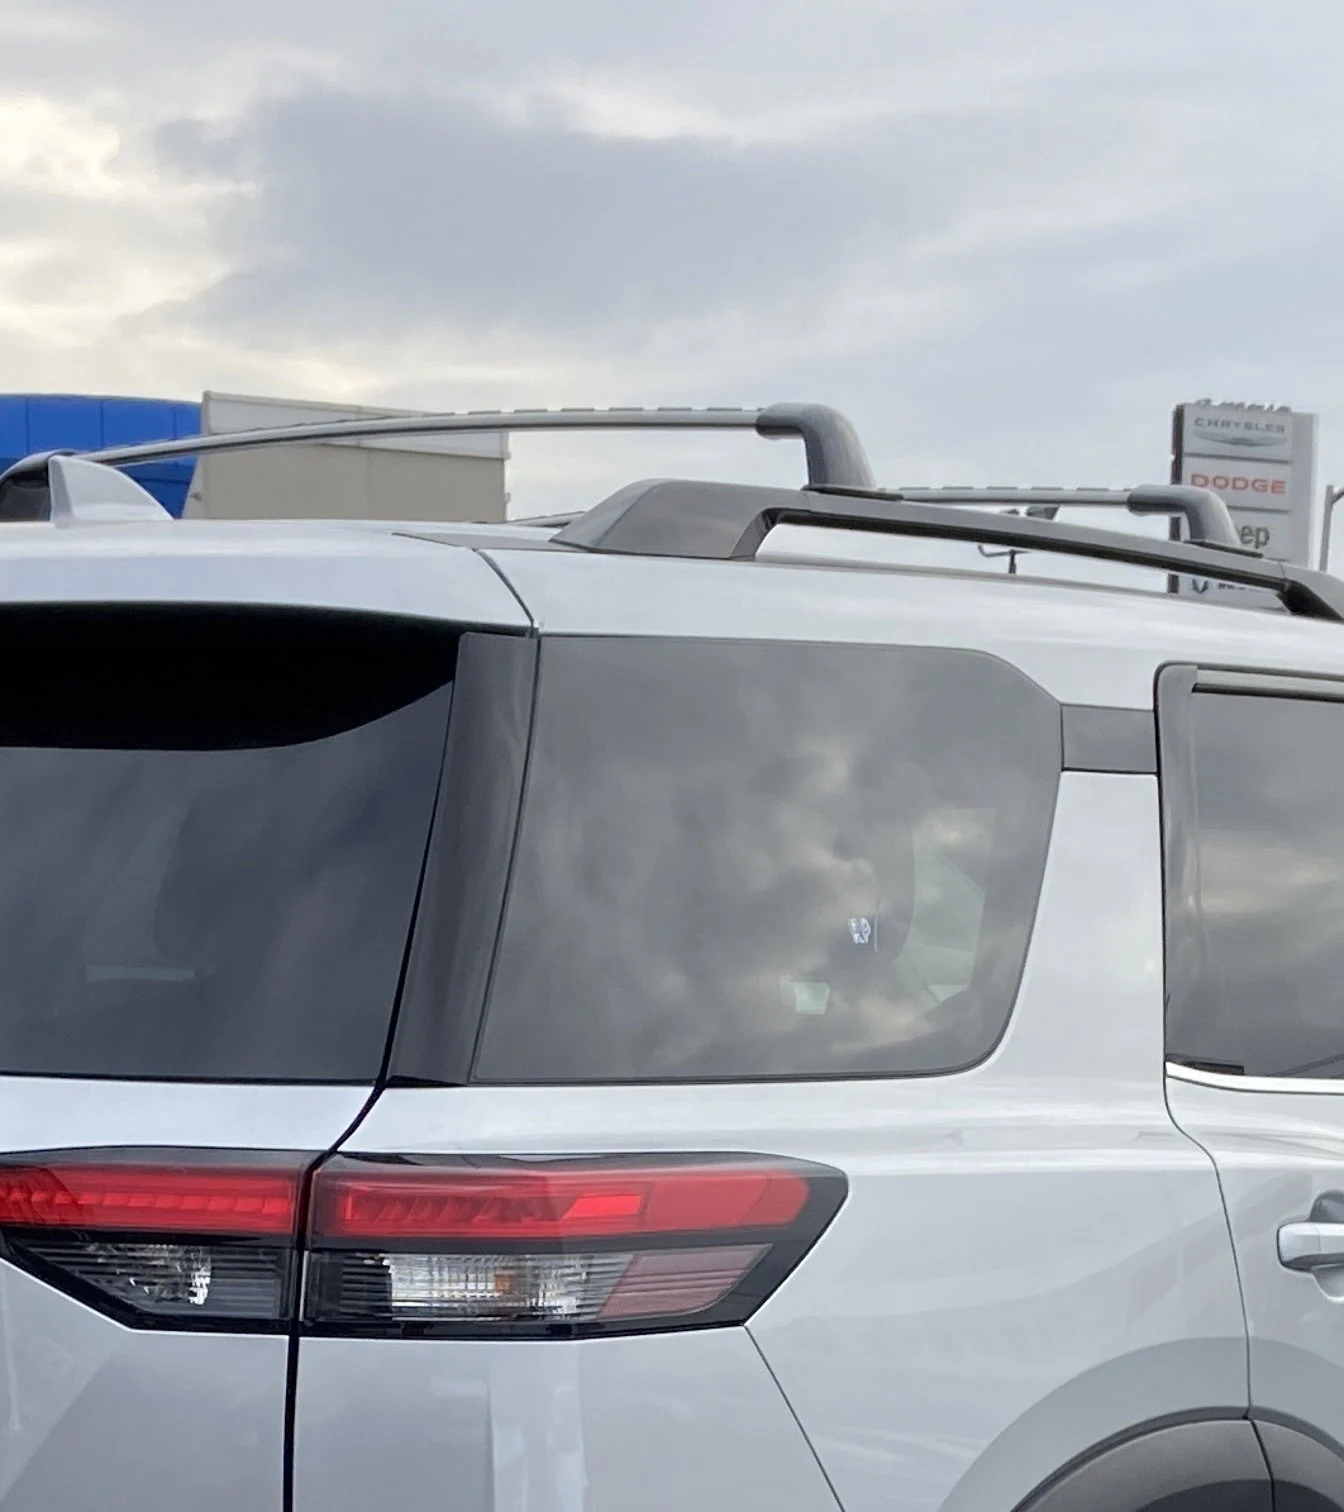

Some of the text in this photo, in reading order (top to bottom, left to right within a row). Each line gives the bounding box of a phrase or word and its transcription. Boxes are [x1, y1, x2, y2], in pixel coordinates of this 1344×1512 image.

[1194, 417, 1286, 433] CHRYSLER
[1191, 473, 1287, 494] DODGE
[1240, 524, 1270, 549] ep
